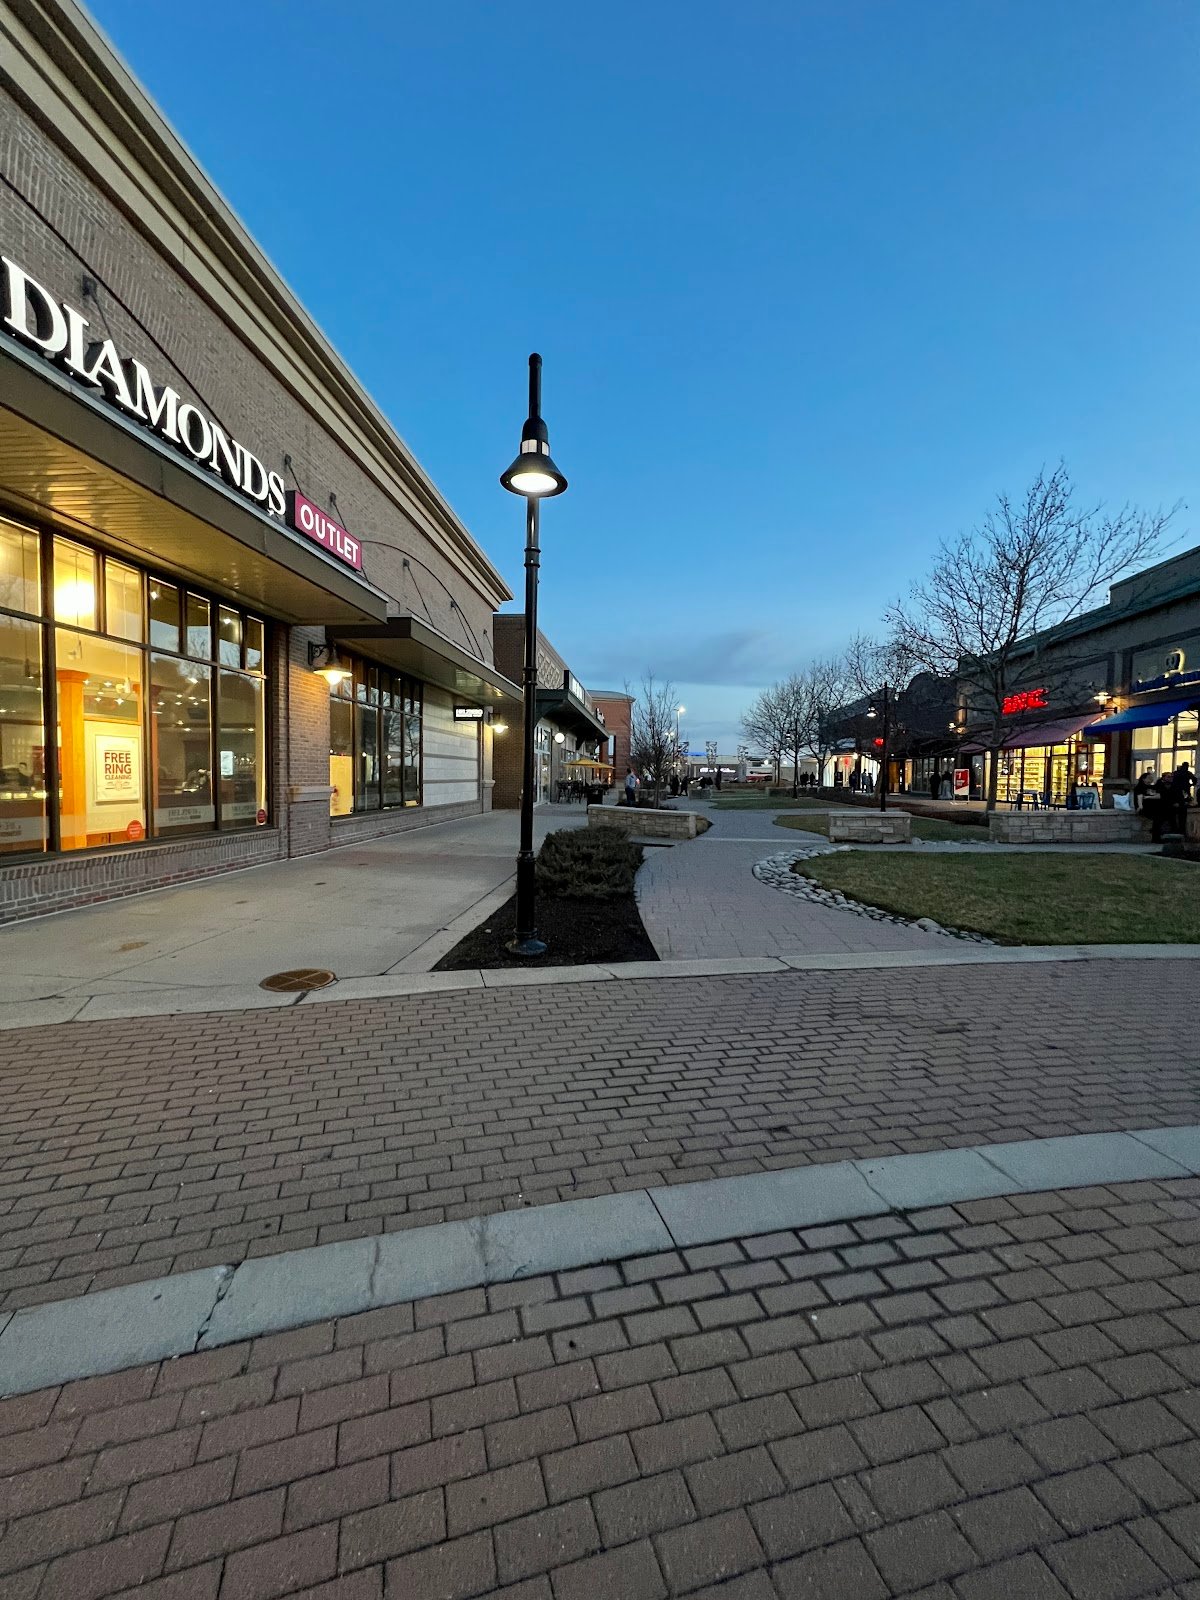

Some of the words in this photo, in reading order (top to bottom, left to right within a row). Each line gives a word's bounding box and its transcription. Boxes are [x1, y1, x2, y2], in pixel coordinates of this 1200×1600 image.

[1, 255, 286, 516] DIAMONDS
[300, 504, 359, 563] OUTLET
[104, 752, 131, 763] FREE
[104, 763, 132, 774] RING
